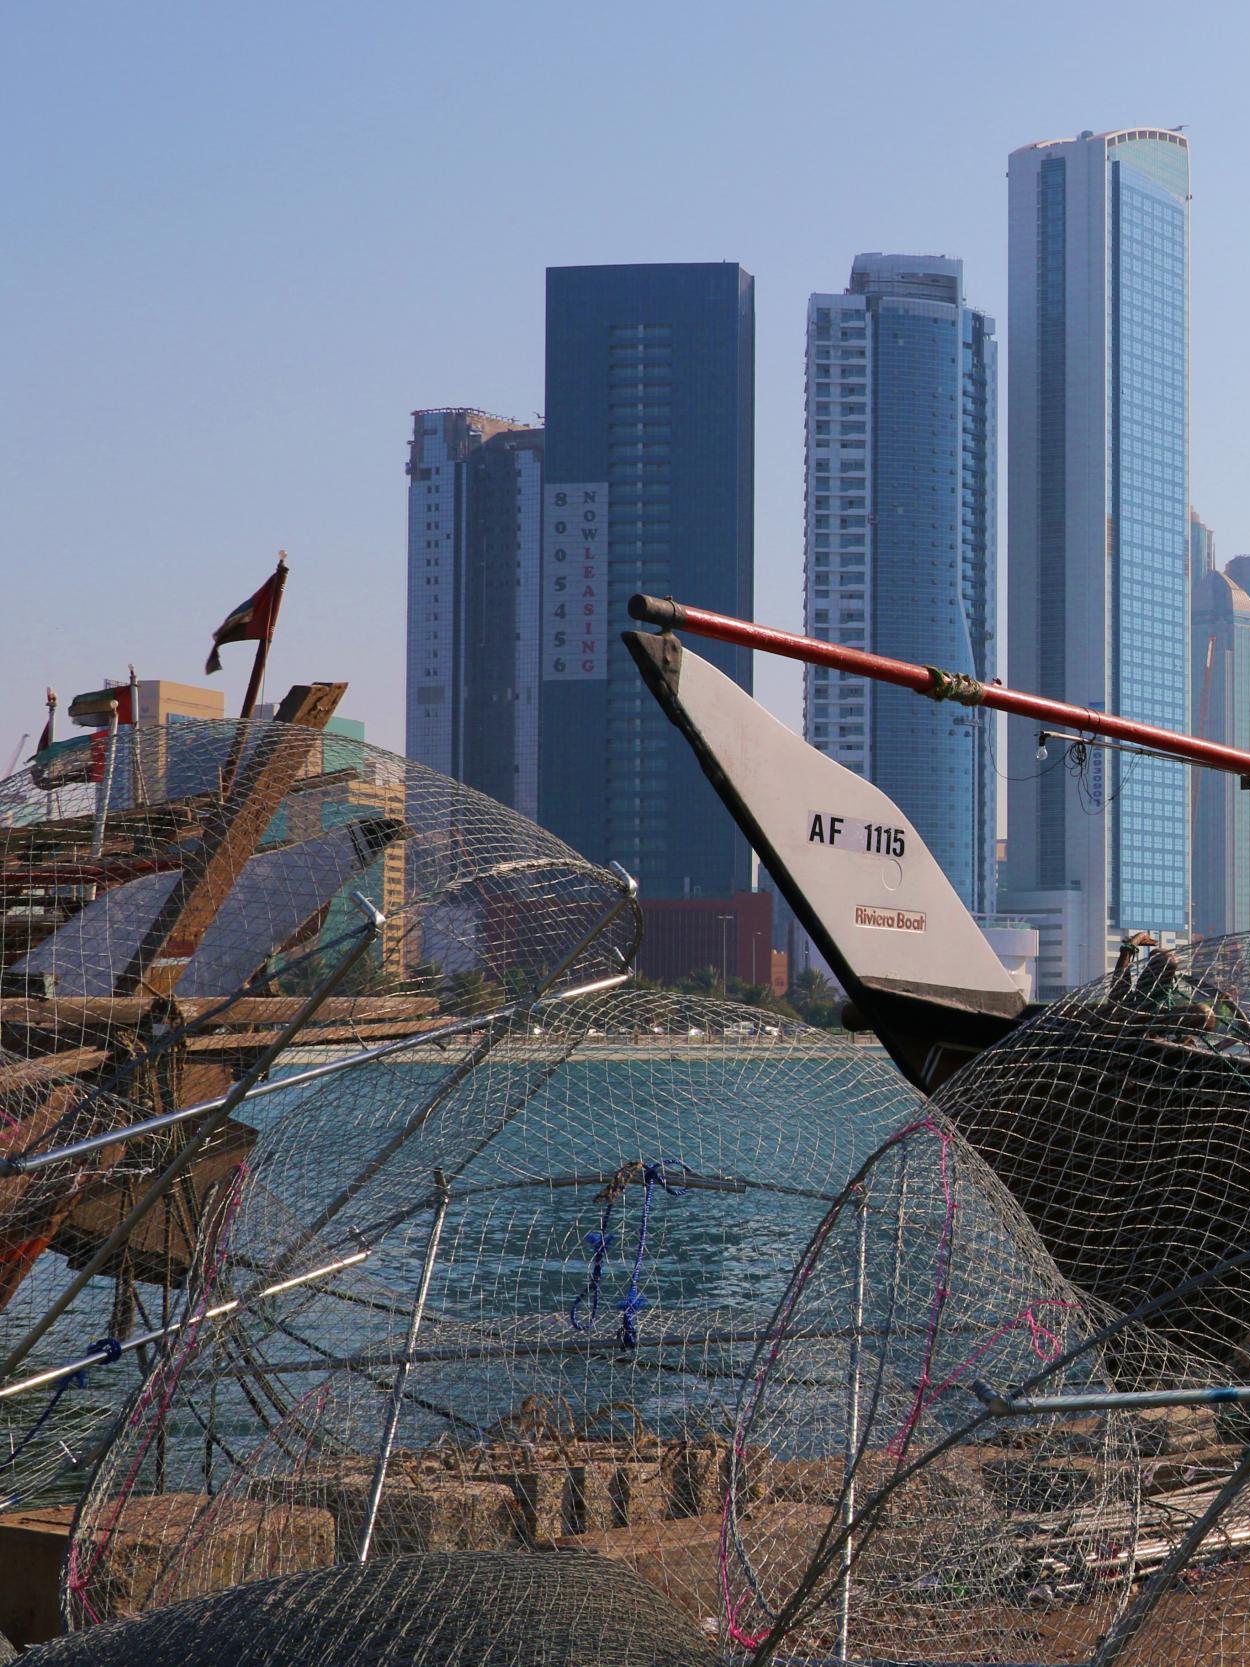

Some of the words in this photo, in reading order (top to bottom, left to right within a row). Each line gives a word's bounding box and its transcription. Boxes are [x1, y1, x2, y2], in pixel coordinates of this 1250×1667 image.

[582, 491, 598, 541] NOW
[553, 492, 567, 672] 8005456
[582, 548, 595, 672] LEASING
[809, 814, 844, 845] AF
[864, 824, 905, 857] 1115
[855, 907, 894, 926] Riviera
[896, 912, 924, 930] Boat
